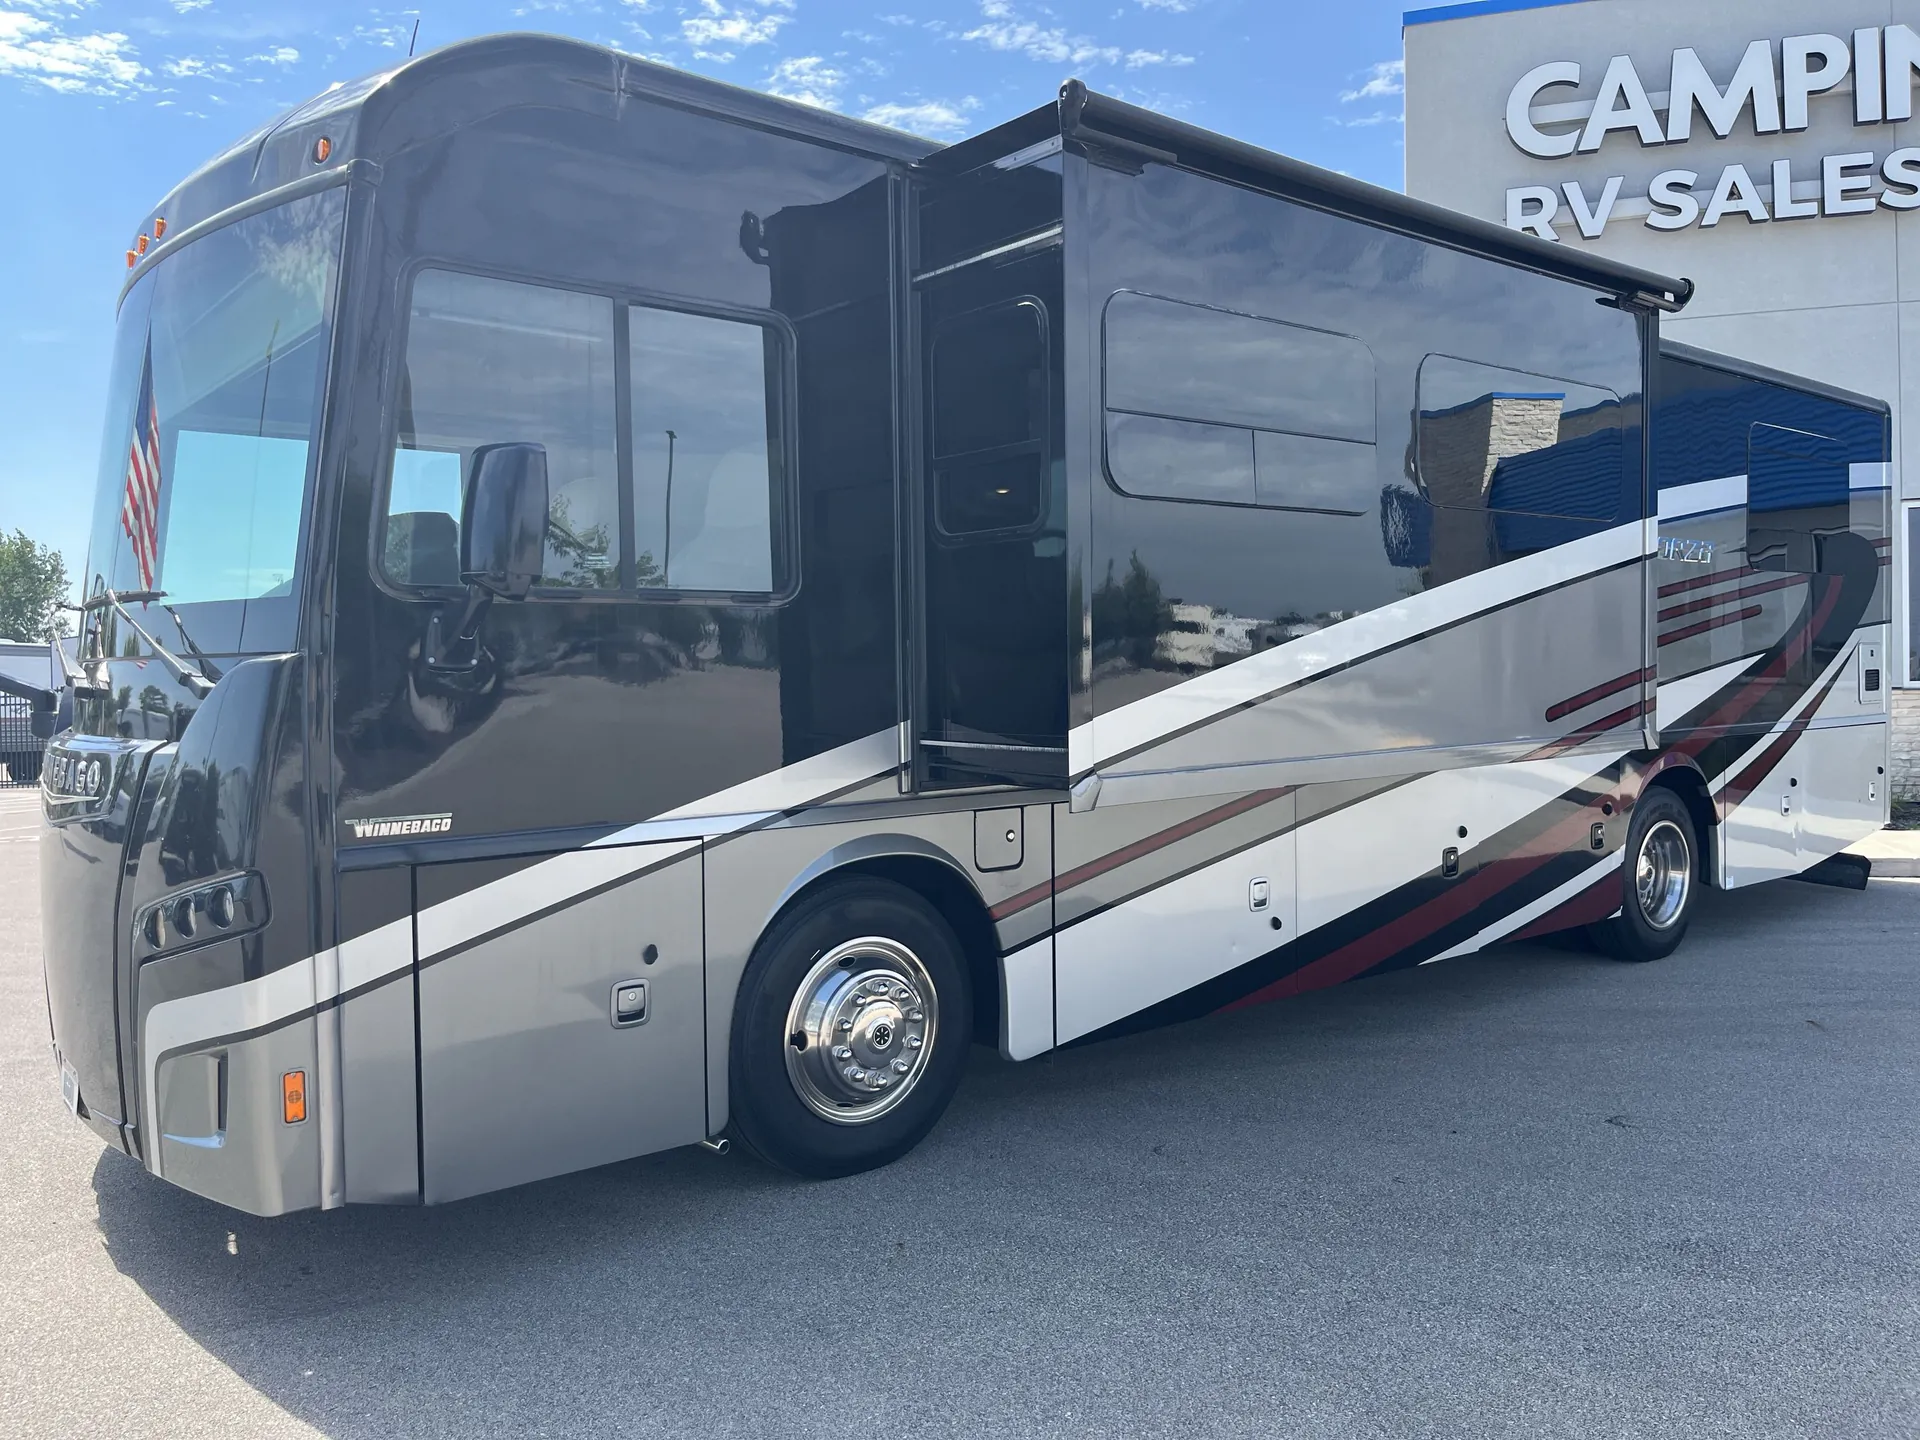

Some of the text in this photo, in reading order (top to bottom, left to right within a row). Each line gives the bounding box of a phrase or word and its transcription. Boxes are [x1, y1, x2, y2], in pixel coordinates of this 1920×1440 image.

[1505, 24, 1920, 159] CAMPIN
[1504, 147, 1920, 241] RV SALES
[346, 814, 452, 838] WINNEBAGO
